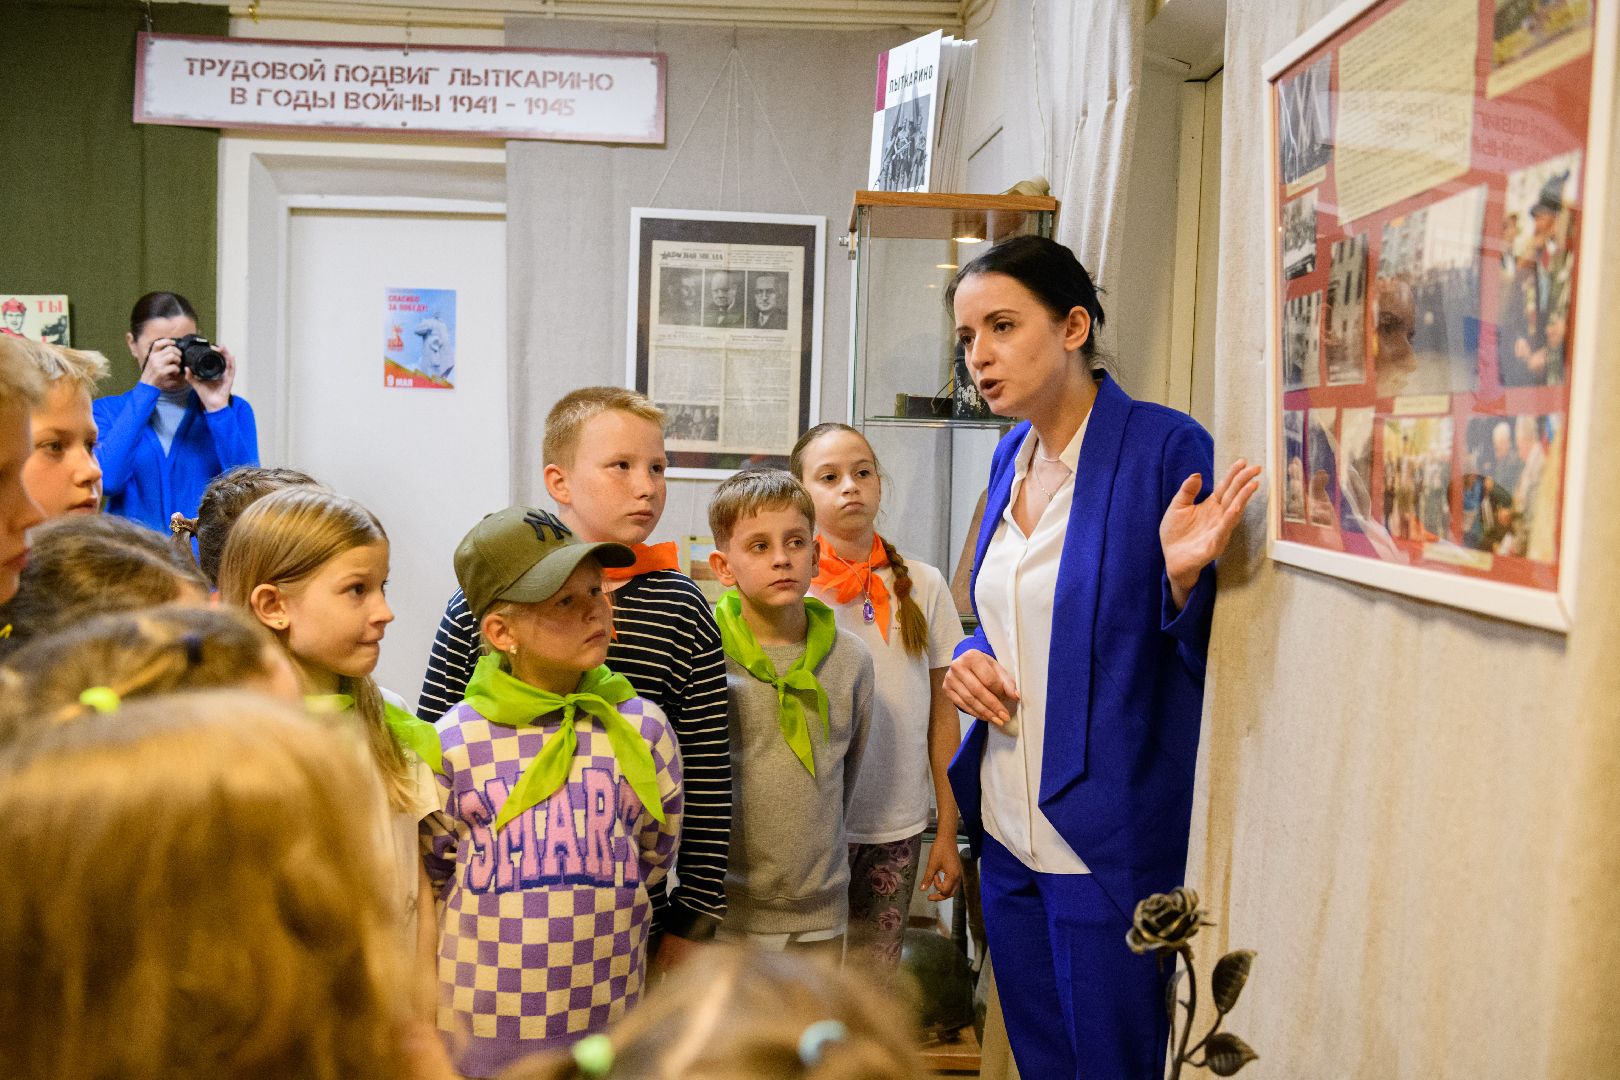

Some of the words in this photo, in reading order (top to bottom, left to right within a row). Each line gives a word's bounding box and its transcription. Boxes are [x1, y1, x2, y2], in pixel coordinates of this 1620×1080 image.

[185, 57, 326, 82] ТРУДОВОЙ
[334, 63, 439, 88] ПОДВИГ
[448, 67, 614, 91] ЛЫТКАРИНО
[888, 64, 933, 94] ЛЫТКАРИНО
[230, 86, 248, 105] В
[256, 87, 336, 112] ГОДЫ
[344, 88, 440, 113] ВОЙНЫ
[449, 94, 497, 114] 1941
[524, 96, 576, 117] 1945
[36, 300, 63, 313] ТЫ
[524, 508, 572, 541] NY
